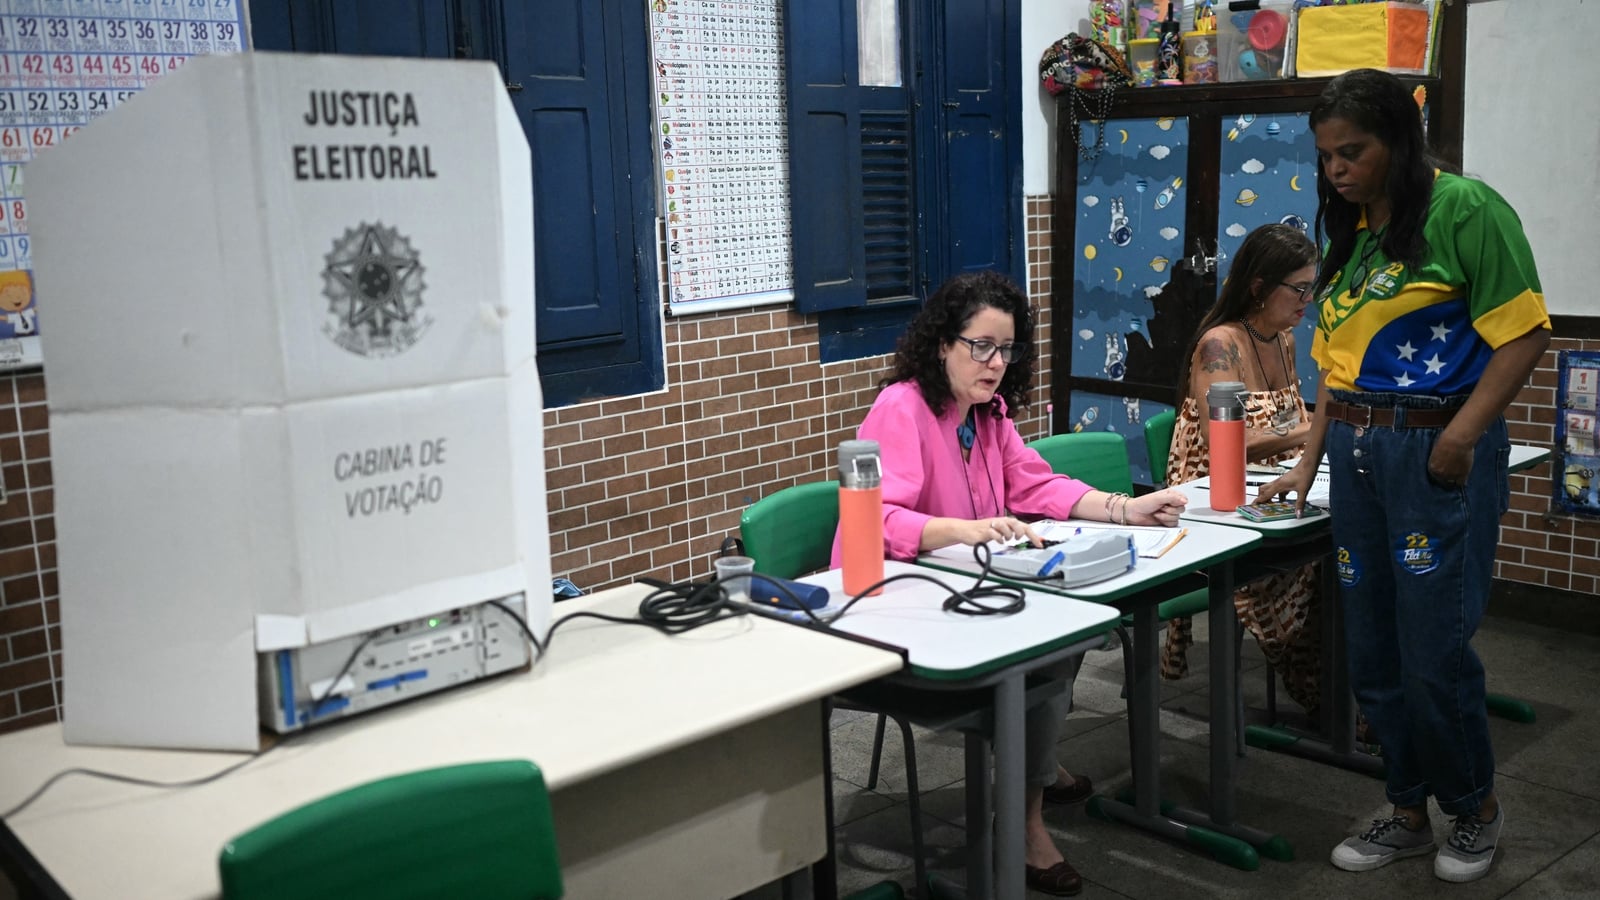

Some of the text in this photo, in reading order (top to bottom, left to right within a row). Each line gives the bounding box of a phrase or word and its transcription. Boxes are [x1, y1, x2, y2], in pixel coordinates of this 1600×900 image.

[16, 18, 38, 37] 32
[47, 18, 69, 38] 33
[78, 19, 98, 38] 34
[107, 20, 127, 38] 35
[134, 20, 154, 39] 36
[163, 21, 181, 40] 37
[190, 22, 208, 40] 38
[216, 23, 234, 40] 39
[22, 54, 43, 74] 42
[52, 54, 74, 74] 43
[83, 55, 104, 74] 44
[112, 55, 132, 74] 45
[140, 56, 160, 74] 46
[0, 92, 16, 111] 51
[28, 92, 49, 110] 52
[58, 92, 79, 110] 53
[88, 92, 108, 110] 54
[304, 90, 420, 137] JUSTIÇA
[2, 127, 22, 147] 61
[33, 127, 54, 146] 62
[293, 145, 438, 181] ELEITORAL
[14, 200, 24, 220] 8
[18, 237, 28, 256] 9
[1580, 373, 1587, 384] 1
[1570, 418, 1590, 430] 21
[334, 437, 446, 482] CABINA DE
[344, 473, 442, 518] VOTAÇÃO
[1406, 535, 1429, 548] 22
[1338, 550, 1350, 563] 22
